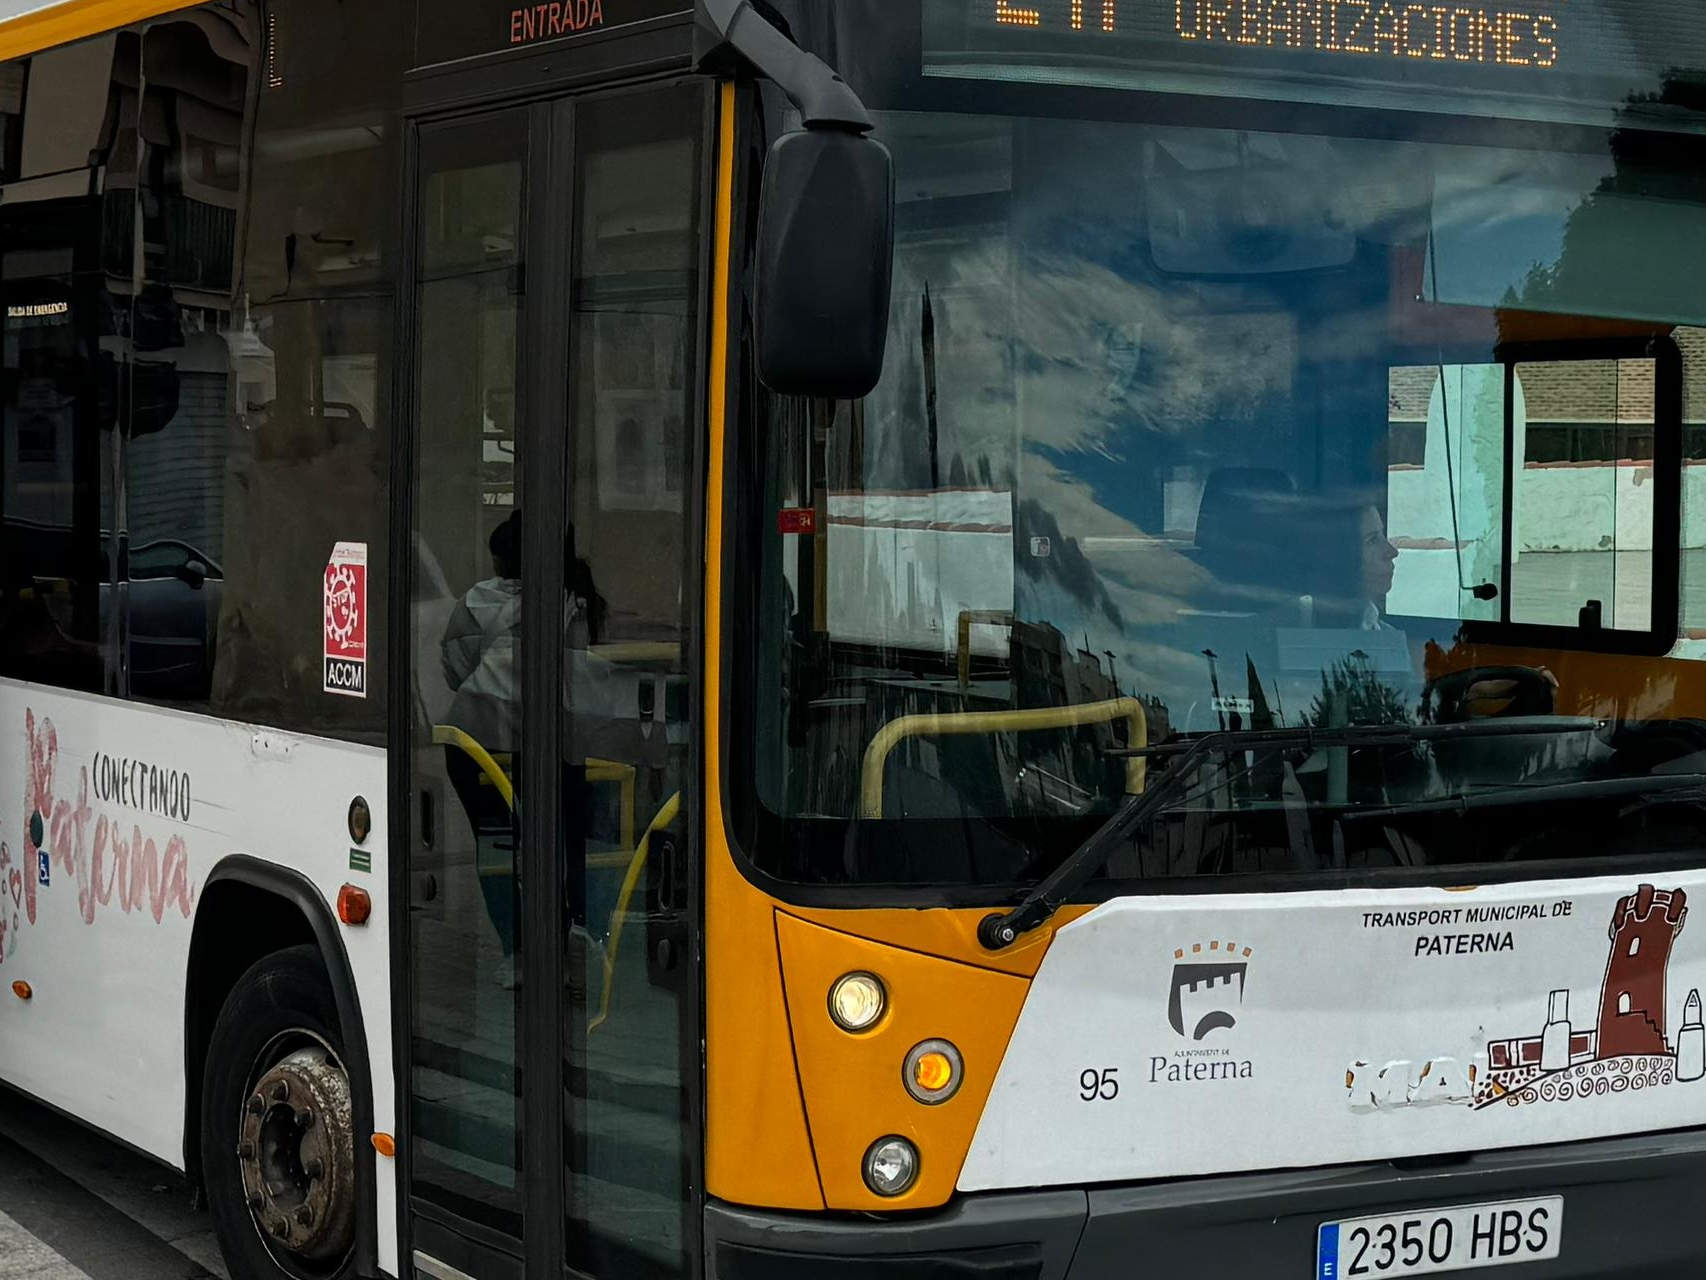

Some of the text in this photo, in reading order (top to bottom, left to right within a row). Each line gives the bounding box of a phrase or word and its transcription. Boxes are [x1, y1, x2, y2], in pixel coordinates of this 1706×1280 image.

[327, 663, 362, 689] ACCM
[93, 751, 190, 822] CONECTANDO
[1361, 900, 1573, 928] TRANSPORT MUNICIPAL DE
[1414, 931, 1514, 957] PATERNA
[1148, 1057, 1254, 1083] Paterna
[1079, 1067, 1119, 1102] 95
[1324, 1207, 1549, 1276] E 2350 HBS
